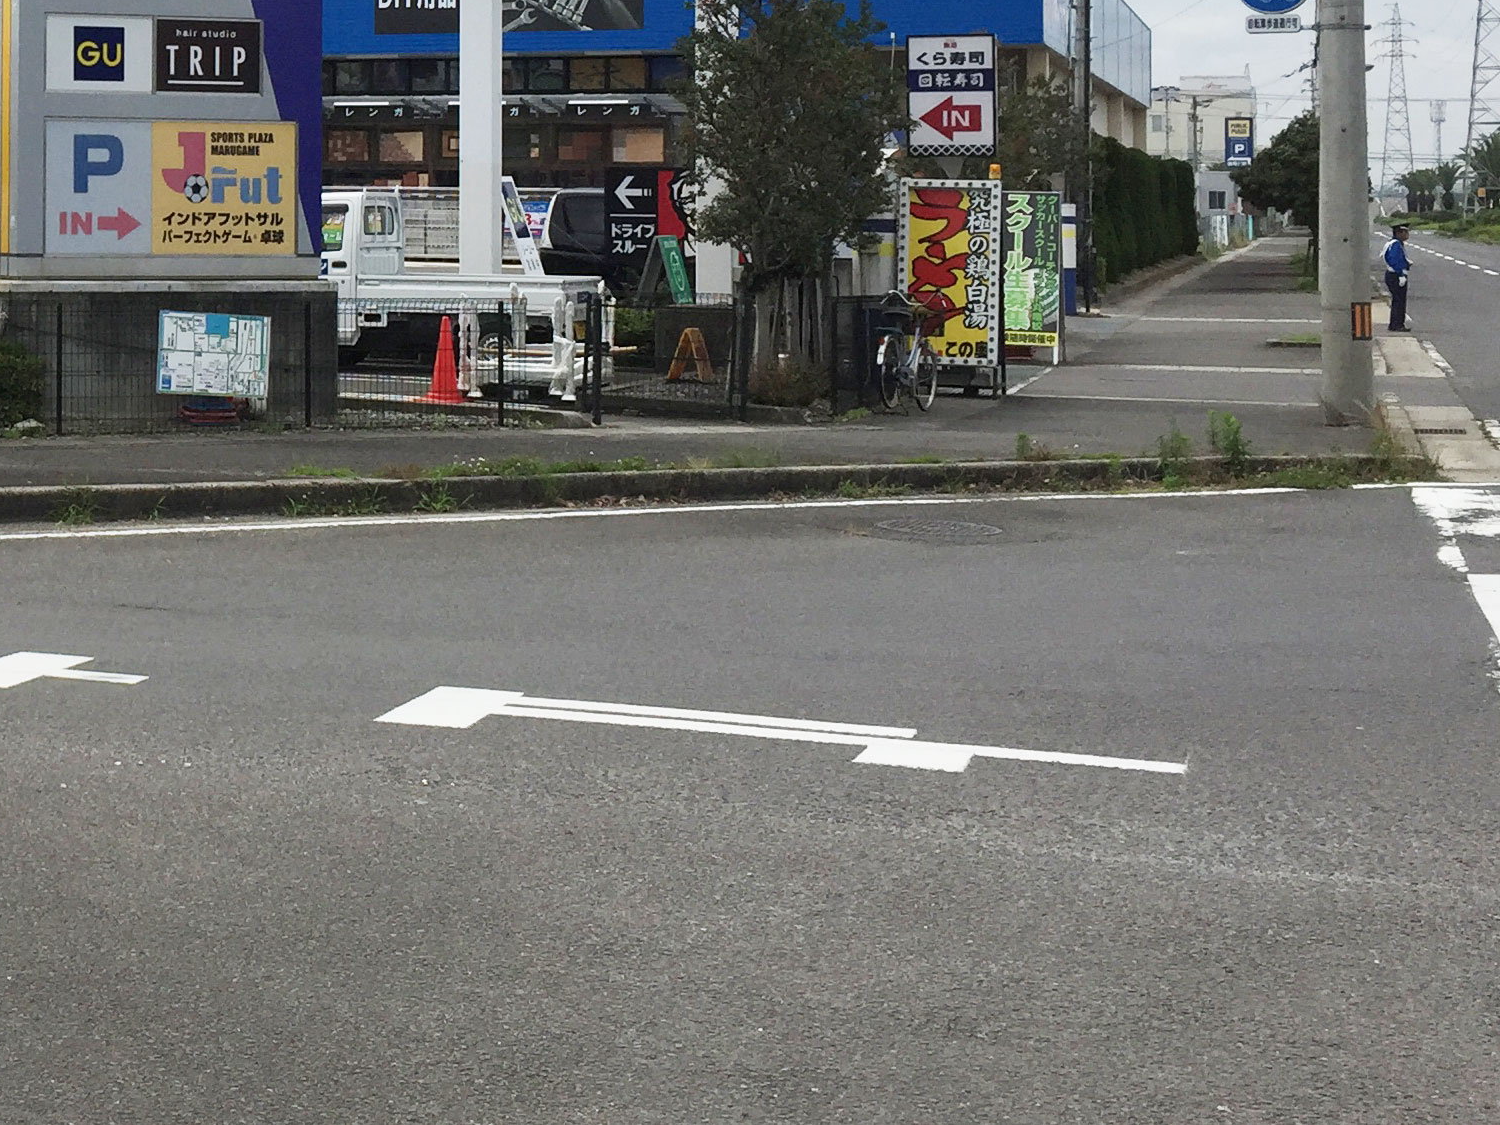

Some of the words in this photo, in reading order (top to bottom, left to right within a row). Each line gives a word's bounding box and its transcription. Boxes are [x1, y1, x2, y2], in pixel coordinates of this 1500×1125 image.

[77, 40, 123, 67] GU
[165, 45, 247, 76] TRIP
[916, 51, 985, 66] くら寿司
[942, 110, 971, 127] IN
[211, 132, 245, 144] SPORTS
[248, 133, 274, 144] PLAZA
[211, 145, 260, 156] MARUGAME
[1234, 143, 1245, 154] P
[73, 133, 124, 194] P
[59, 211, 93, 235] IN
[162, 212, 283, 226] インドアフットサル
[612, 239, 647, 254] スルー
